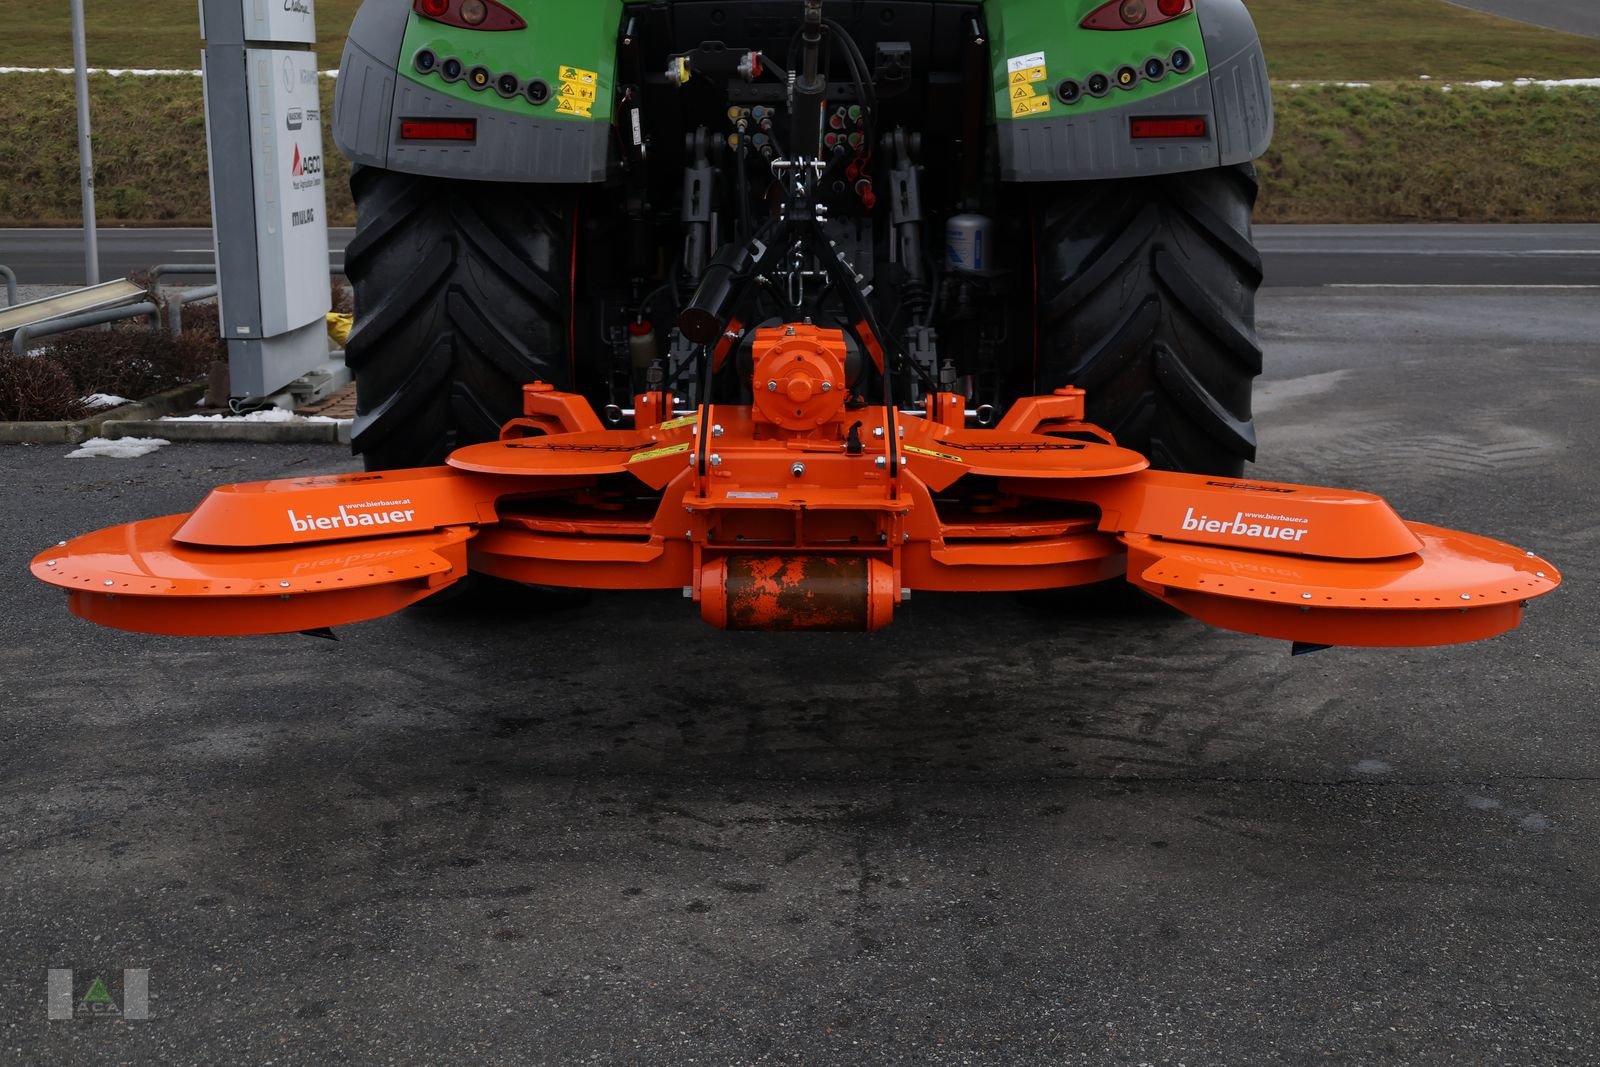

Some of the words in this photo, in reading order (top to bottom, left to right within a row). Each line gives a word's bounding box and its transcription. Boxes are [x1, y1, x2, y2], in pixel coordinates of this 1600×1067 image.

[303, 155, 320, 174] AGCO
[345, 498, 411, 510] www.bierbauer.at
[287, 505, 415, 532] bierbauer
[1181, 507, 1308, 541] bierbauer
